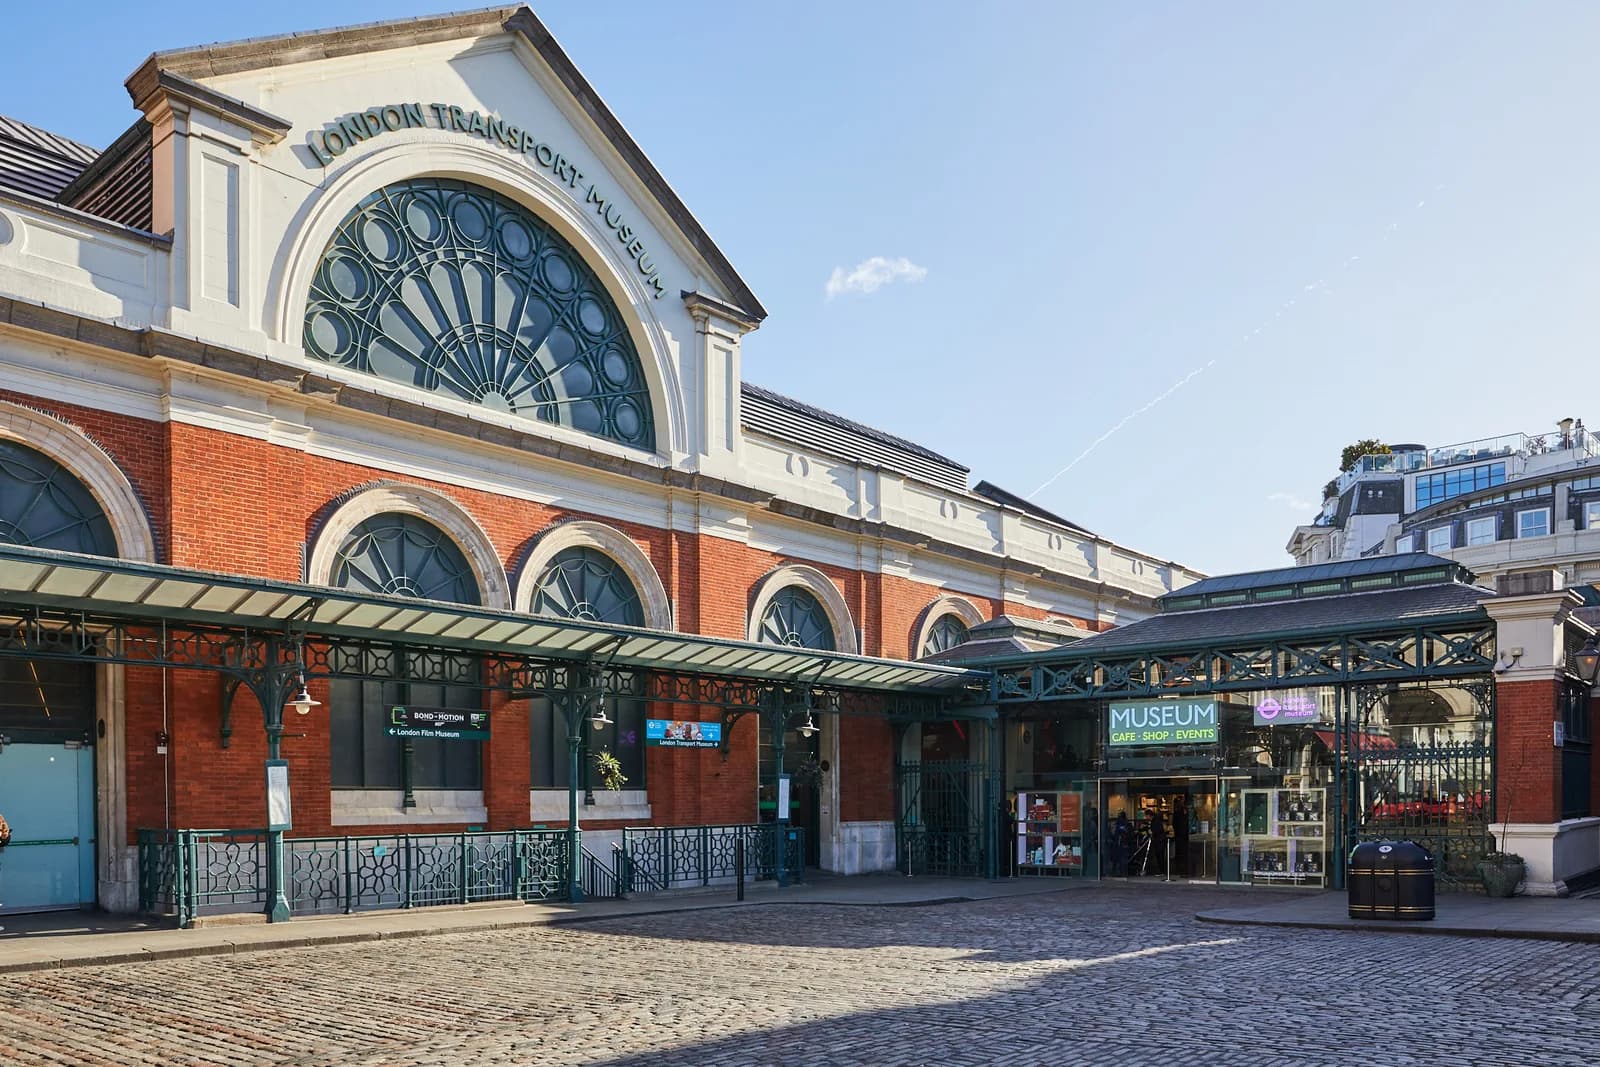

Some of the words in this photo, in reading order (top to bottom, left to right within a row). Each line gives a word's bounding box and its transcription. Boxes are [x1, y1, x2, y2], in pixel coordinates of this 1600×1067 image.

[307, 102, 427, 167] LONDON
[431, 103, 584, 189] TRANSPORT
[586, 184, 668, 300] MUSEUM
[1111, 704, 1215, 729] MUSEUM
[397, 728, 420, 736] London
[435, 730, 460, 738] Museum
[1112, 732, 1136, 742] CAFE
[1142, 731, 1169, 741] SHOP
[1176, 729, 1215, 739] EVENTS
[677, 739, 696, 747] Transport
